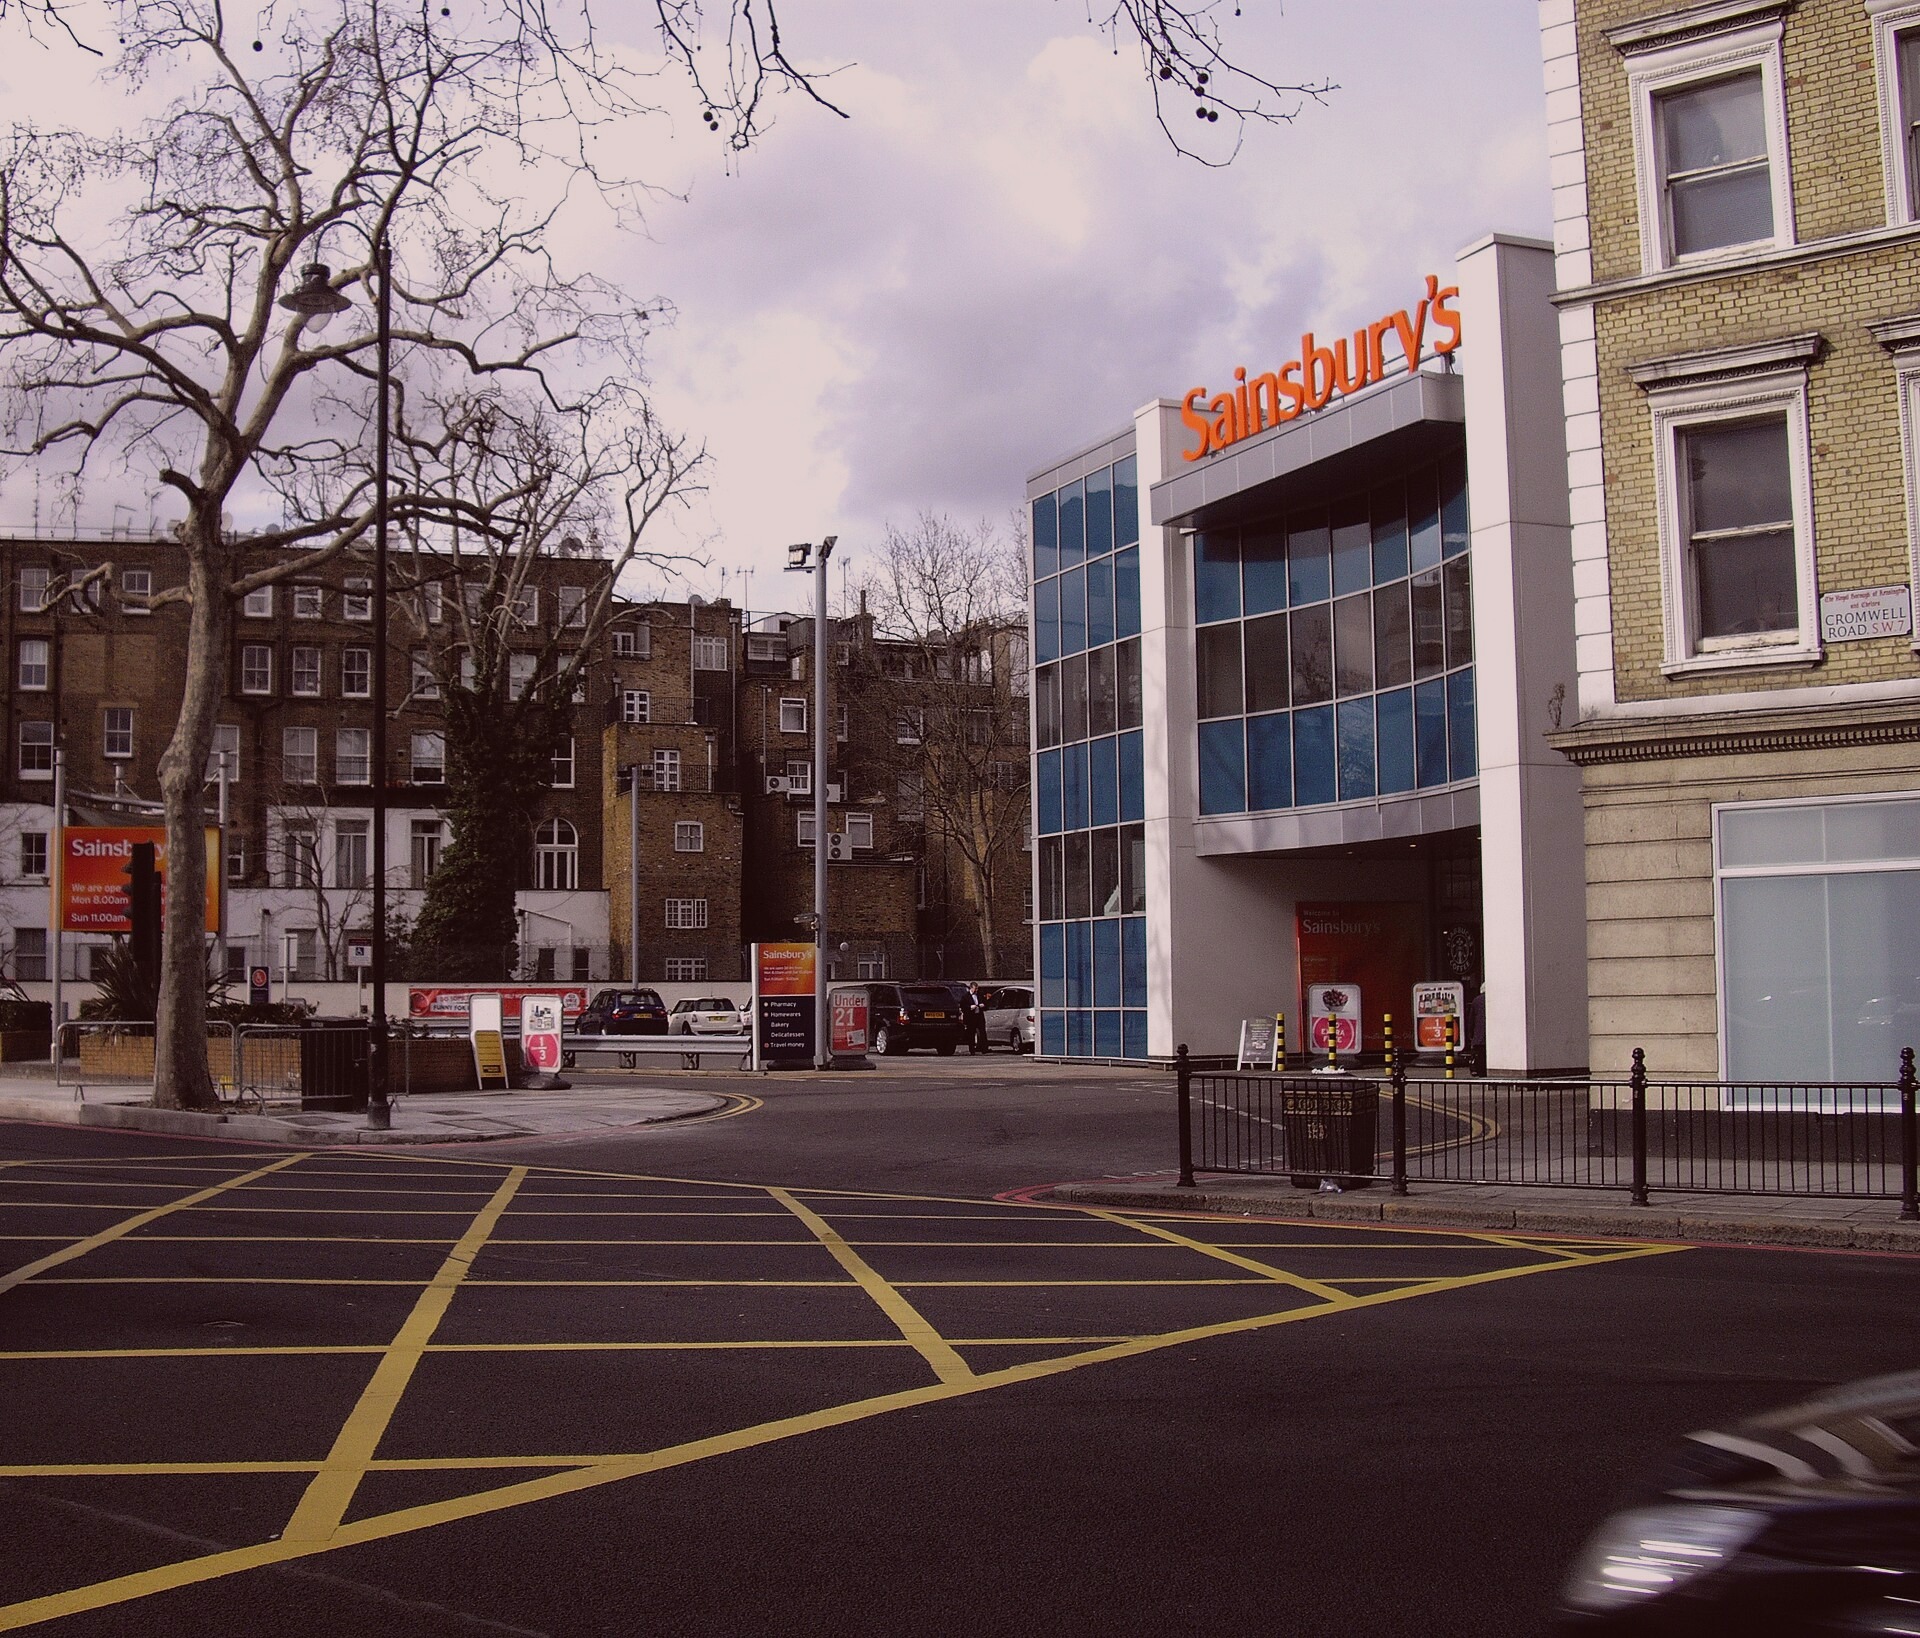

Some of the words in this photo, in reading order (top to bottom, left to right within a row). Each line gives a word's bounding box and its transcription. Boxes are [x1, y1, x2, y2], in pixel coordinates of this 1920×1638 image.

[1180, 275, 1462, 461] Sainsbury's
[1825, 607, 1906, 626] CROMWELL
[71, 883, 85, 892] We
[104, 885, 122, 894] ope
[71, 895, 91, 904] Mon
[93, 895, 129, 904] 8.00am
[71, 913, 89, 922] Sun
[91, 913, 127, 922] 11.00am
[1302, 919, 1382, 938] Sainsbury's
[763, 950, 812, 960] Sainsbury's
[834, 994, 865, 1006] Under
[835, 1008, 855, 1026] 21
[1435, 1018, 1440, 1027] 1
[1434, 1029, 1441, 1038] 3
[539, 1036, 544, 1047] 1
[539, 1049, 546, 1061] 3
